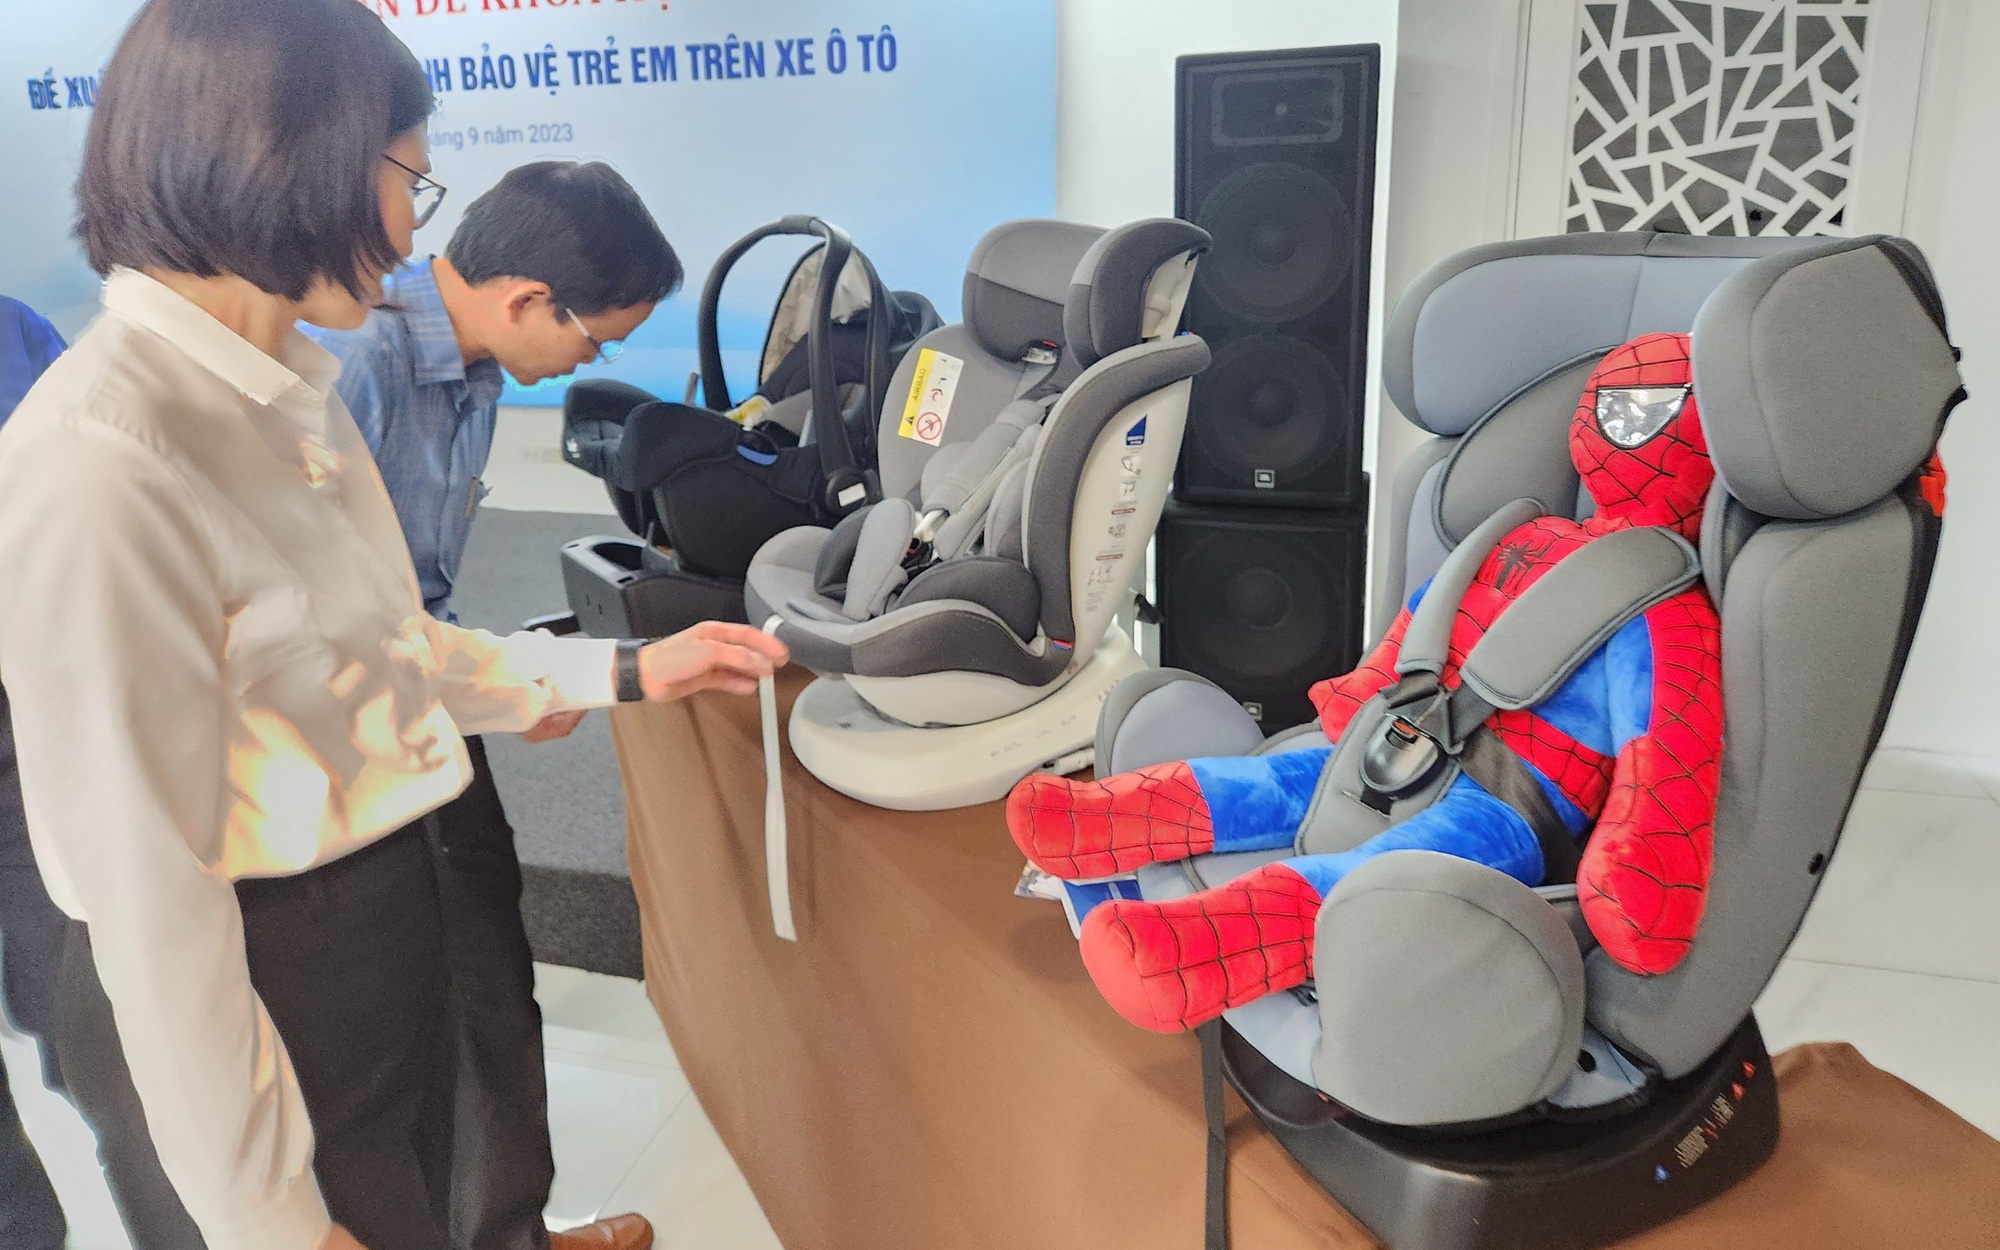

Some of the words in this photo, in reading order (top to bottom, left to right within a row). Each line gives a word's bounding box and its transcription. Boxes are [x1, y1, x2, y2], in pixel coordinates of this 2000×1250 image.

[459, 42, 517, 91] BẢO
[524, 43, 560, 95] VỆ
[567, 36, 622, 86] TRẺ
[631, 45, 678, 83] EM
[685, 33, 766, 81] TRÊN
[774, 38, 816, 77] XE
[826, 27, 847, 75] Ô
[857, 24, 898, 72] TÔ
[467, 126, 479, 145] 9
[528, 123, 574, 144] 2023
